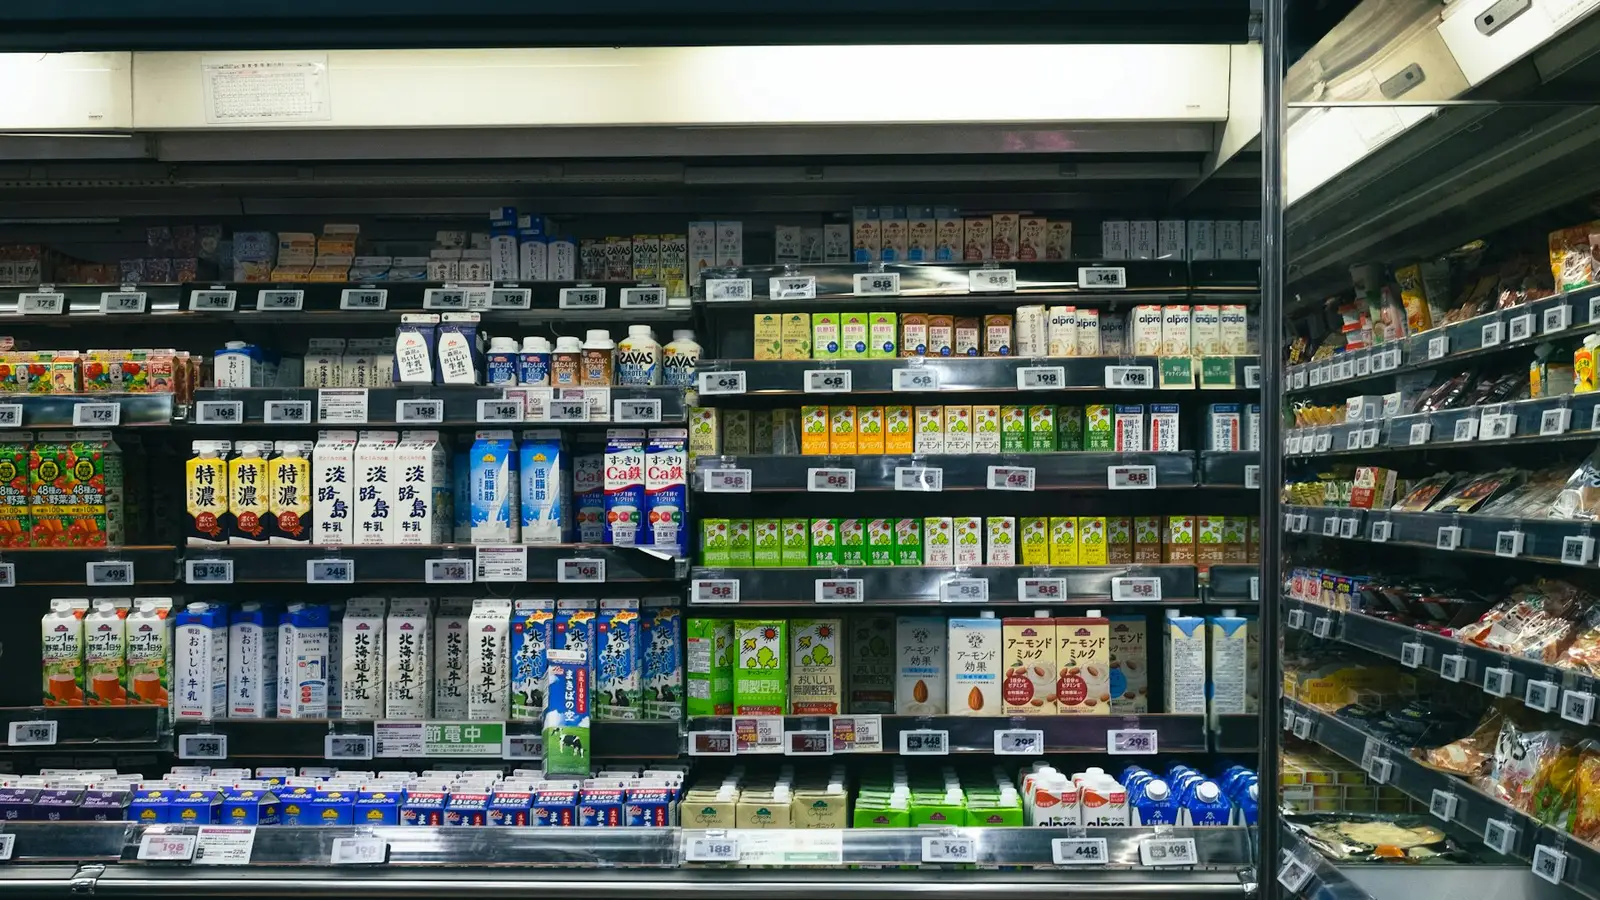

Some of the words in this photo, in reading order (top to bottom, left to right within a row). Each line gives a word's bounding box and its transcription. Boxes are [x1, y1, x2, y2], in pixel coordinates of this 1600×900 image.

[607, 247, 630, 256] SAVAS
[634, 244, 658, 253] SAVAS
[662, 243, 686, 253] SAVAS
[872, 280, 892, 288] 88
[989, 276, 1008, 284] 88
[725, 286, 743, 294] 128
[1052, 317, 1075, 327] alpro
[1077, 319, 1097, 330] alpro
[1139, 315, 1161, 325] alpro
[1167, 315, 1189, 325] alpro
[1102, 322, 1123, 333] alpro
[401, 354, 426, 363] おいしい
[443, 354, 468, 364] おいしい
[619, 352, 654, 365] SAVAS
[664, 356, 697, 368] SAVAS
[406, 361, 423, 370] 牛乳
[448, 362, 466, 371] 牛乳
[824, 377, 843, 385] 68
[913, 376, 932, 384] 68
[1037, 374, 1057, 382] 198
[1126, 373, 1145, 381] 198
[718, 378, 738, 387] 68
[216, 408, 235, 416] 168
[284, 408, 303, 416] 128
[416, 407, 435, 415] 158
[497, 407, 515, 415] 148
[563, 406, 582, 414] 148
[634, 406, 653, 414] 178
[0, 411, 14, 419] 78
[918, 441, 942, 449] アーモンド
[947, 441, 971, 449] アーモンド
[975, 441, 999, 449] アーモンド
[1033, 440, 1051, 448] 抹茶
[1090, 440, 1109, 448] 抹茶
[609, 455, 641, 466] すっきり
[650, 455, 682, 466] すっきり
[606, 466, 643, 481] Ca鉄
[648, 466, 684, 481] Ca鉄
[1128, 473, 1147, 481] 88
[724, 477, 743, 485] 88
[828, 476, 847, 484] 88
[1008, 475, 1026, 483] 88
[195, 464, 216, 506] 特濃
[237, 464, 258, 506] 特濃
[278, 464, 299, 506] 特濃
[484, 468, 495, 501] 低脂肪
[534, 468, 546, 501] 低脂肪
[37, 485, 62, 495] 48種の
[73, 485, 97, 495] 48種の
[318, 465, 349, 519] 淡路島
[359, 465, 390, 519] 淡路島
[398, 465, 428, 519] 淡路島
[322, 521, 343, 532] 牛乳
[363, 521, 384, 532] 牛乳
[402, 521, 422, 532] 牛乳
[816, 552, 833, 560] 特濃
[844, 552, 860, 560] 特濃
[872, 551, 889, 560] 特濃
[900, 551, 916, 560] 特濃
[930, 553, 948, 561] 紅茶
[959, 553, 976, 561] 紅茶
[992, 553, 1010, 561] 紅茶
[106, 570, 125, 578] 498
[209, 566, 225, 574] 248
[327, 568, 346, 576] 248
[445, 568, 464, 576] 128
[577, 566, 596, 575] 168
[712, 587, 731, 595] 88
[836, 587, 855, 595] 88
[961, 586, 980, 594] 88
[1039, 585, 1058, 593] 88
[1133, 585, 1152, 593] 88
[45, 633, 78, 642] コップ1杯で
[88, 632, 121, 641] コップ1杯で
[130, 632, 162, 642] コップ1杯で
[1110, 633, 1143, 644] ーモンド
[45, 643, 79, 651] 野菜の1日分
[88, 642, 122, 651] 野菜の1日分
[130, 643, 163, 651] 野菜の1日分
[1008, 638, 1052, 649] アーモンド
[1061, 638, 1105, 649] アーモンド
[903, 645, 940, 655] アーモンド
[1016, 649, 1043, 660] ミルク
[1069, 649, 1096, 660] ミルク
[528, 629, 543, 686] 北のおいしさ
[612, 629, 629, 686] 北のおいしさ
[910, 655, 931, 666] 効果
[957, 651, 995, 661] アーモンド
[187, 636, 199, 702] おいしい牛乳
[240, 635, 252, 699] おいしい牛乳
[283, 635, 291, 700] おいしい牛乳
[354, 632, 371, 701] 北海道牛乳
[398, 632, 415, 701] 北海道牛乳
[447, 631, 463, 698] 北海道牛乳
[481, 634, 497, 704] 北海道牛乳
[603, 644, 616, 687] まる搾り
[964, 661, 987, 672] 効果
[798, 675, 832, 684] おいしい
[738, 679, 782, 694] 調製豆乳
[793, 684, 837, 696] 無調整豆乳
[565, 669, 575, 722] まきばの空
[29, 729, 48, 737] 198
[425, 725, 481, 743] 節電中
[708, 738, 728, 748] 218
[804, 738, 824, 748] 218
[924, 737, 940, 745] 448
[1129, 738, 1149, 746] 298
[199, 743, 219, 751] 258
[345, 743, 364, 752] 218
[405, 796, 443, 804] まきばの空
[807, 807, 833, 820] Organic
[695, 814, 723, 827] Organic
[750, 814, 777, 827] Organic
[163, 843, 184, 851] 198
[709, 845, 731, 853] 188
[945, 845, 967, 853] 168
[1076, 846, 1098, 855] 448
[1169, 845, 1187, 854] 498
